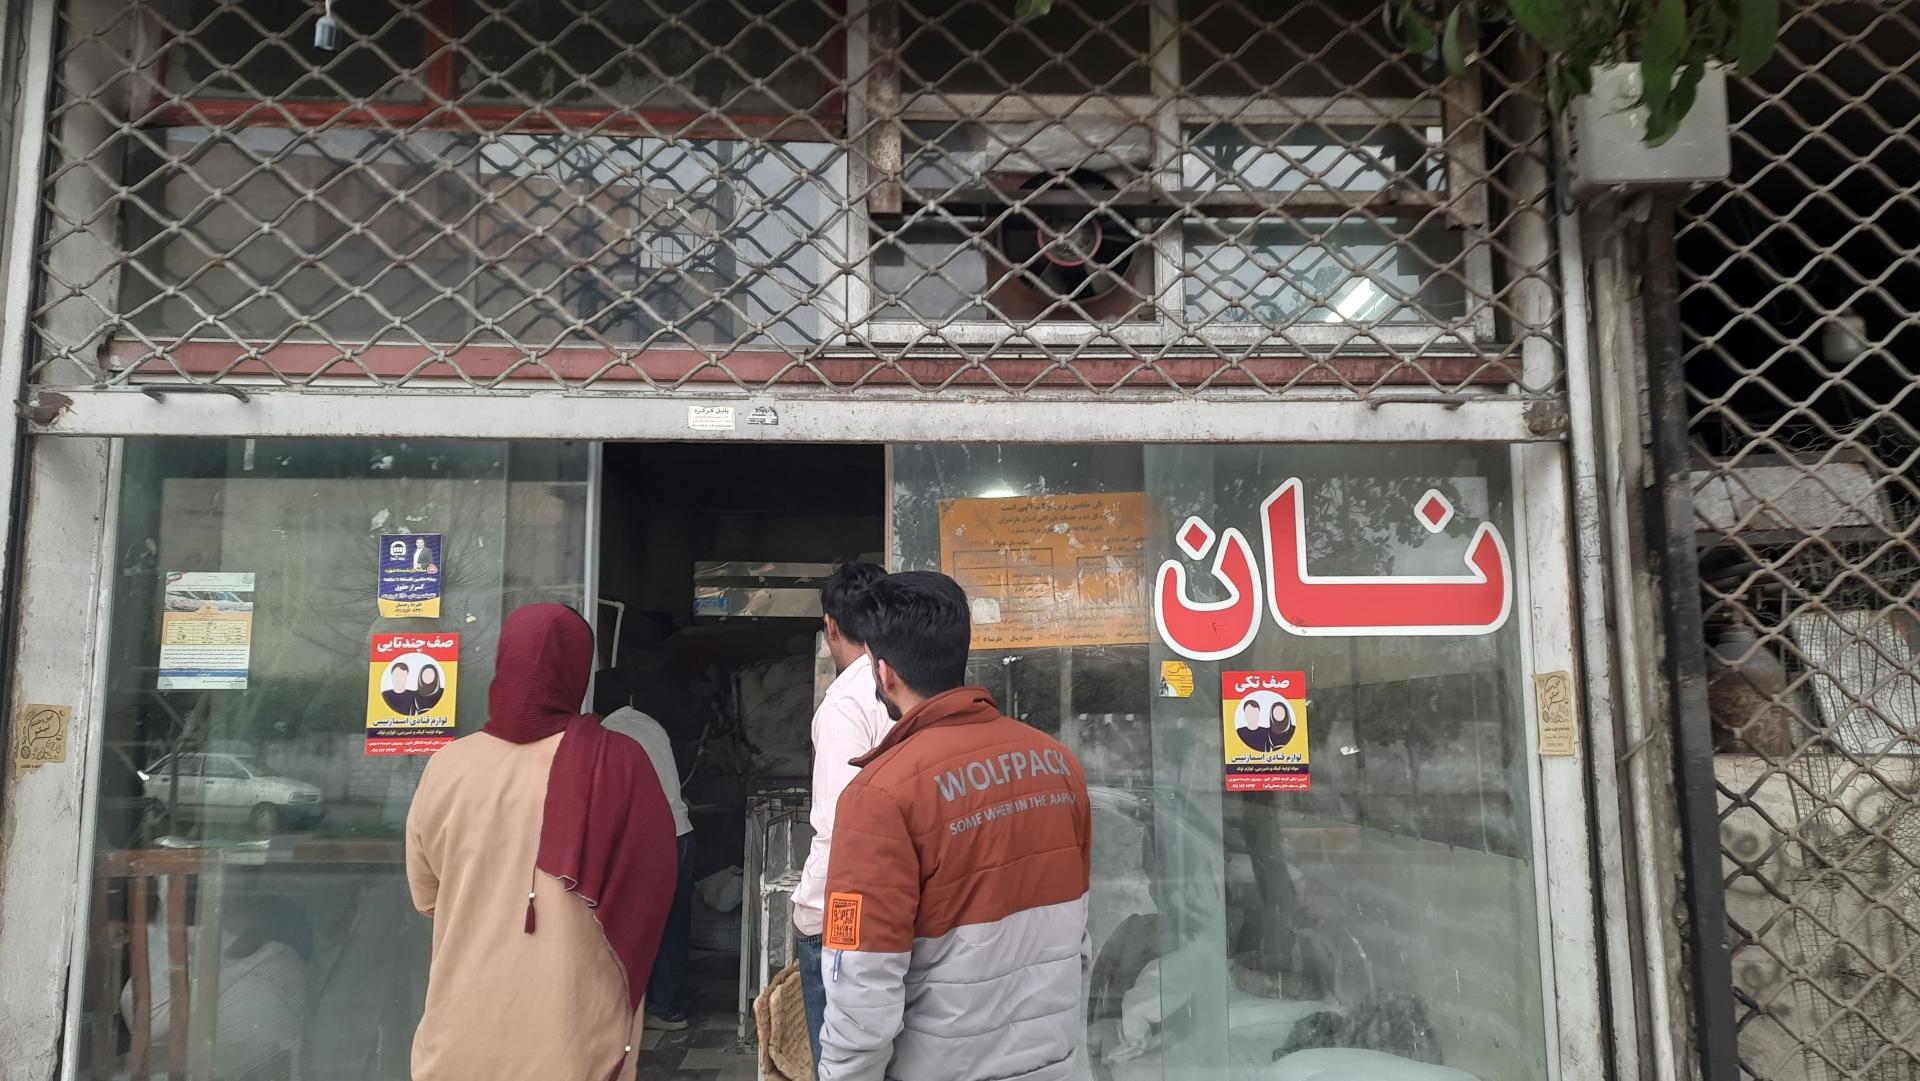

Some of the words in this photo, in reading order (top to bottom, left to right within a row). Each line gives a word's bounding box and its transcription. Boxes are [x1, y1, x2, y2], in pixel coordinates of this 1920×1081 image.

[1154, 477, 1513, 661] نان
[414, 583, 425, 591] کسر
[376, 635, 426, 653] چندتایی
[426, 635, 454, 648] صف
[1234, 675, 1260, 692] تکی
[1262, 675, 1290, 689] صف
[410, 716, 430, 726] قنادی
[431, 716, 448, 726] لوازم
[1266, 753, 1285, 763] قنادی
[1286, 754, 1302, 763] لوازم
[934, 748, 1072, 802] WOLFPACK
[949, 812, 984, 836] SOME
[1015, 799, 1028, 813] IN
[1029, 795, 1048, 809] THE
